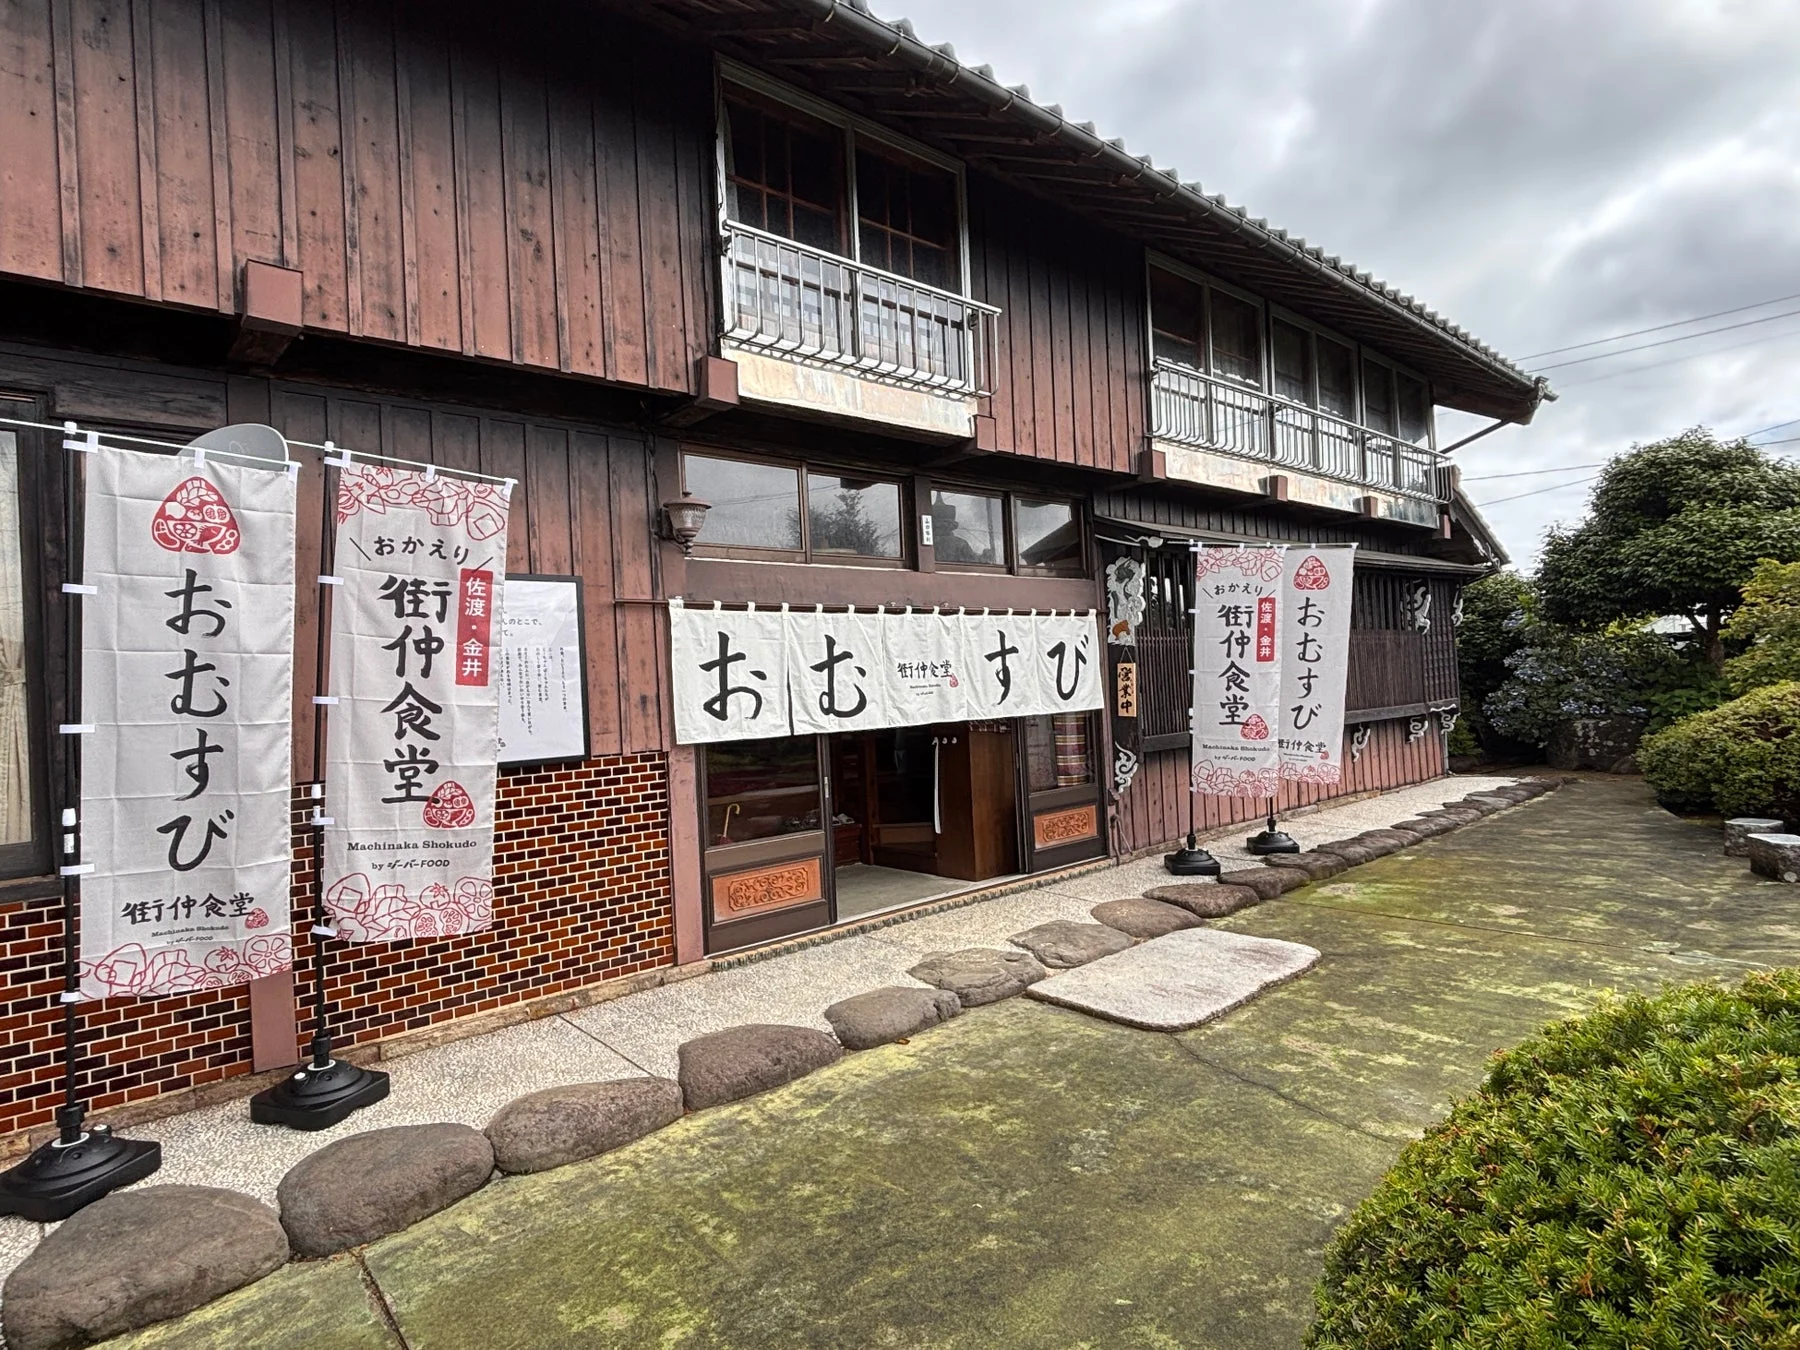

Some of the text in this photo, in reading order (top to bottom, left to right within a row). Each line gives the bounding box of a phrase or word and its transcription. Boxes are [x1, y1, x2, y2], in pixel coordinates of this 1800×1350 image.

[374, 535, 469, 565] おかえり
[1214, 582, 1263, 597] おかえり
[461, 576, 487, 677] 佐渡・金井
[1259, 601, 1273, 657] 佐渡・金井
[896, 659, 953, 679] 街仲食堂
[1216, 604, 1255, 727] 街仲食堂
[1291, 596, 1325, 730] おむすび
[377, 574, 453, 804] 街仲食堂
[1118, 666, 1133, 714] 営業中
[156, 568, 235, 873] おむすび
[1202, 743, 1239, 751] Machinaka
[347, 840, 477, 851] Machinaka Shokudo
[371, 862, 384, 871] by
[120, 891, 255, 925] 街仲食堂
[151, 926, 195, 938] Machinaka
